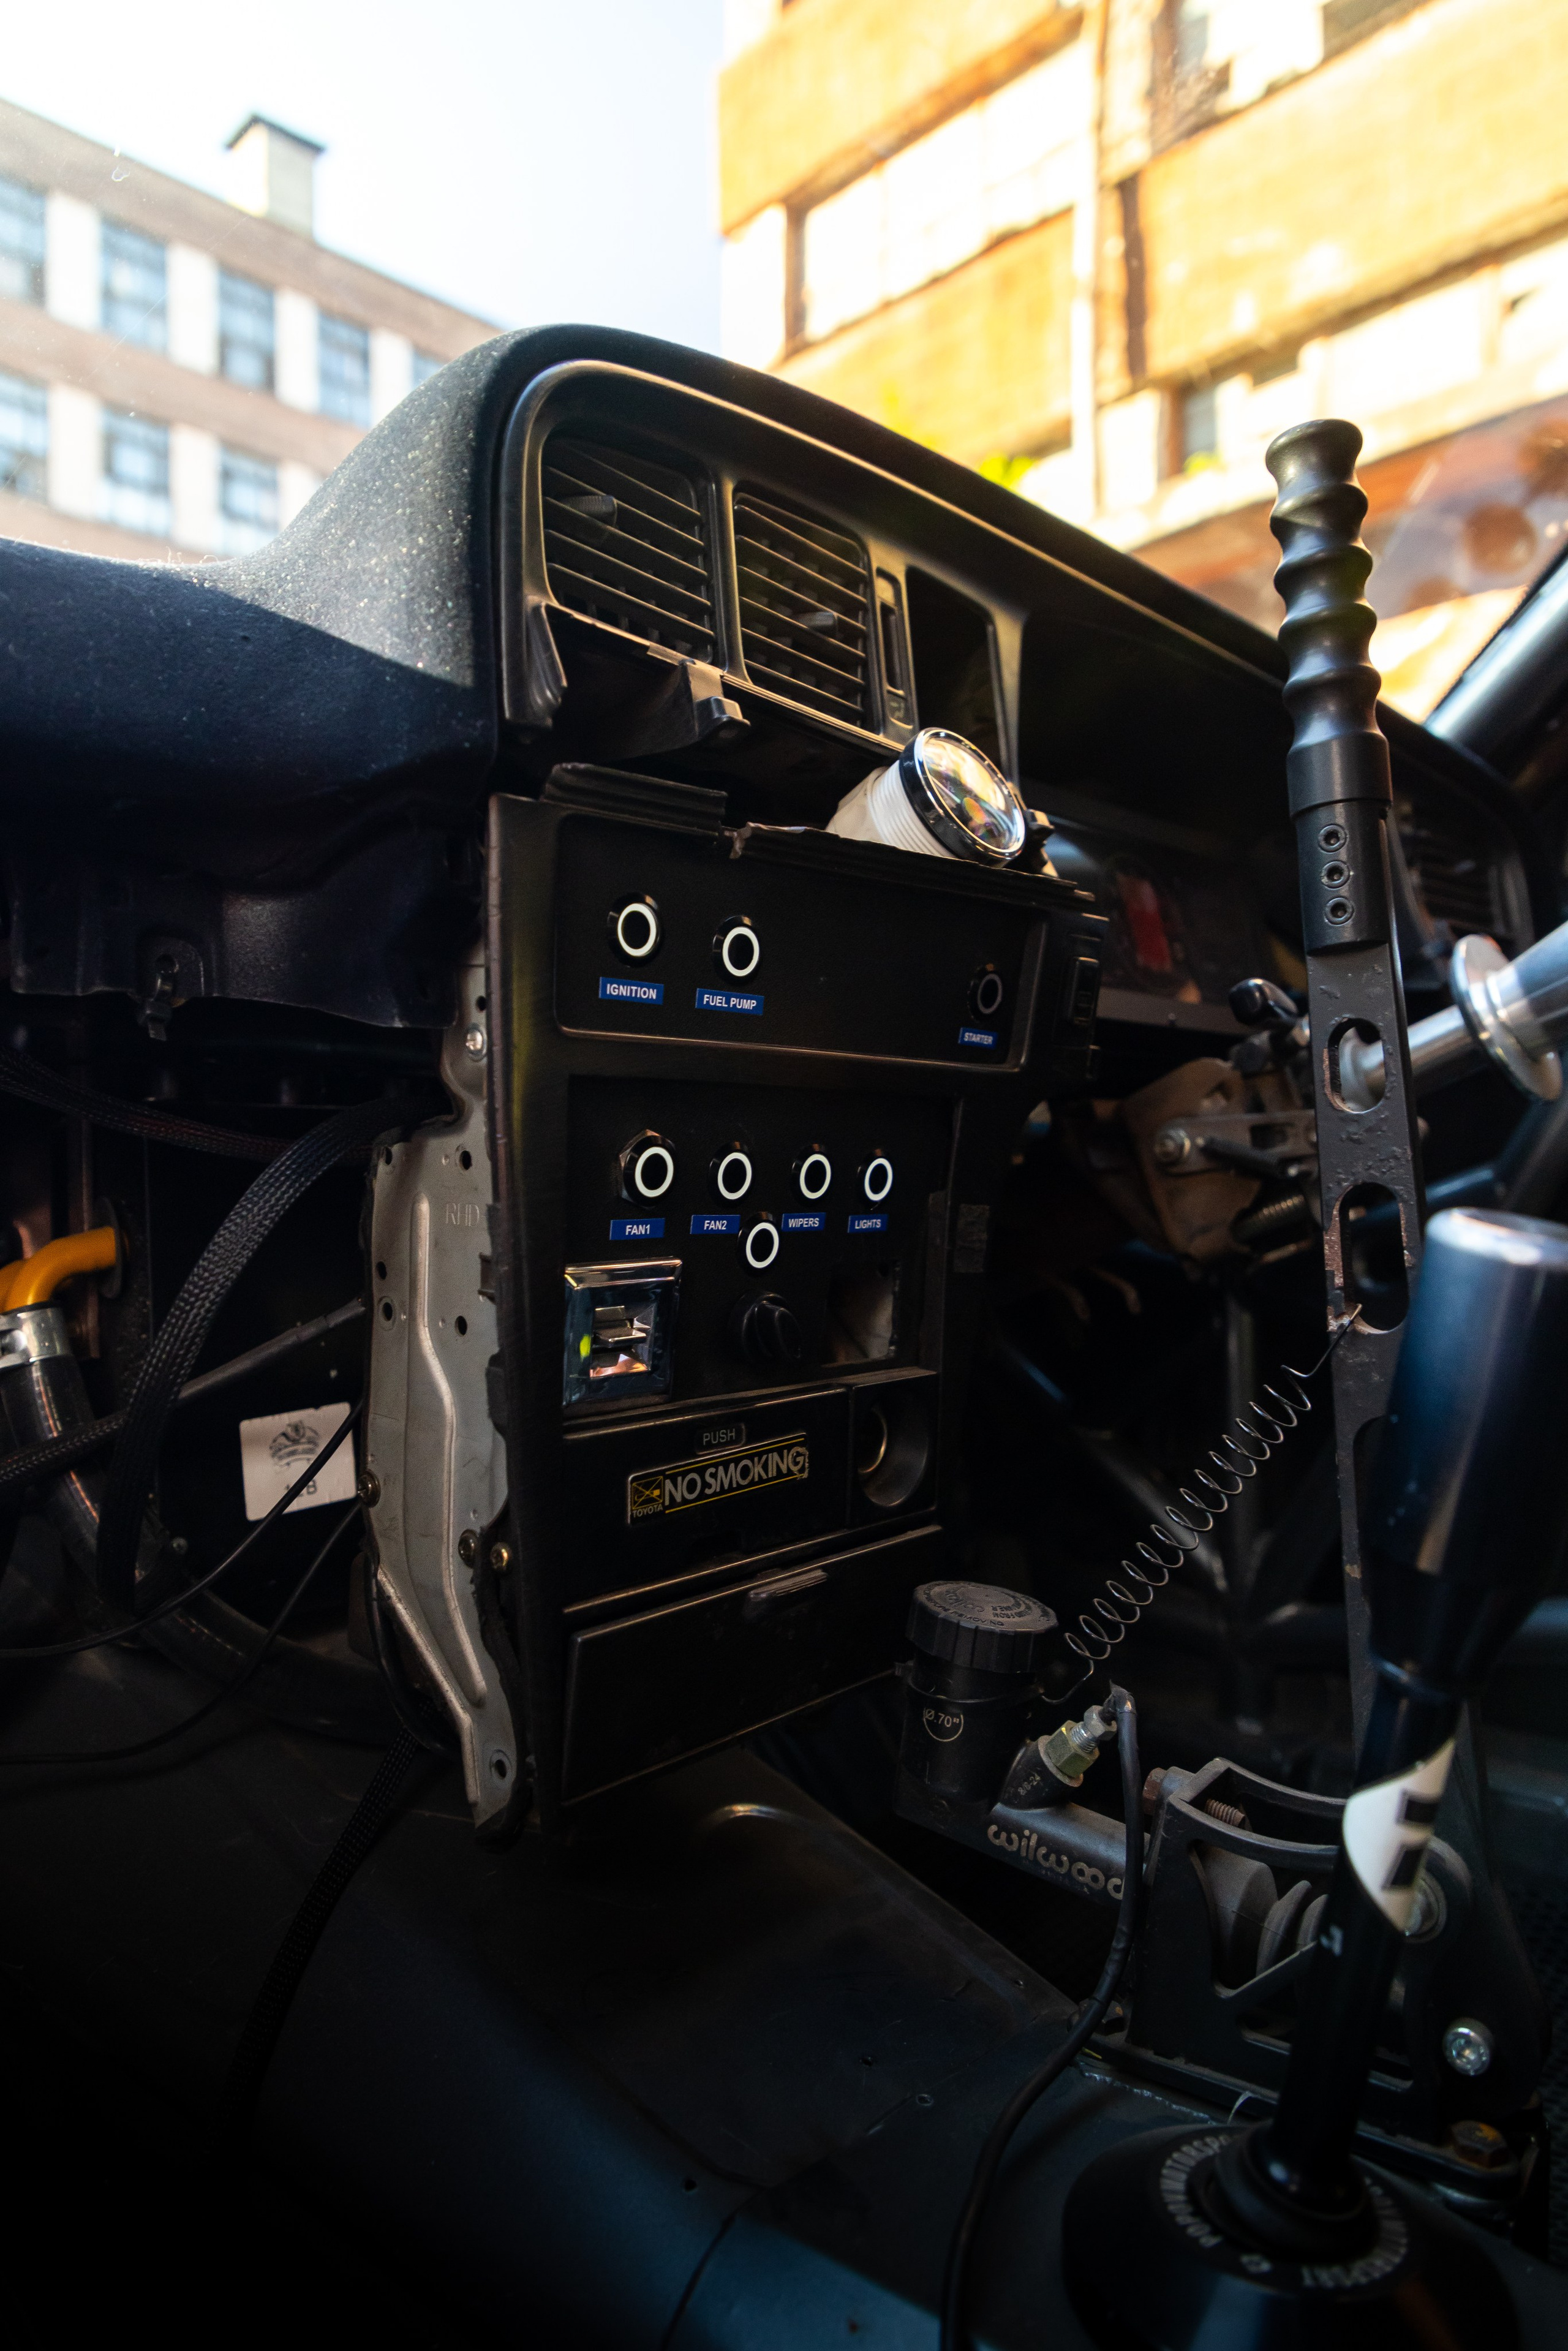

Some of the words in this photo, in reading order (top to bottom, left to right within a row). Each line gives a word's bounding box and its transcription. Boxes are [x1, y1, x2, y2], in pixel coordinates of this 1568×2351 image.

[606, 983, 657, 1000] IGNITION
[703, 994, 728, 1008] FUEL
[729, 997, 757, 1010] PUMP
[963, 1032, 993, 1044] STARTER
[625, 1225, 650, 1236] FAN1
[704, 1219, 727, 1231] FAN2
[788, 1217, 820, 1228] WIPERS
[854, 1218, 881, 1229] LIGHTS
[703, 1428, 736, 1446] PUSH
[664, 1472, 702, 1506] NO
[704, 1446, 805, 1495] SMOKING
[632, 1503, 663, 1519] TOYOTA
[987, 1824, 1125, 1900] wilwood
